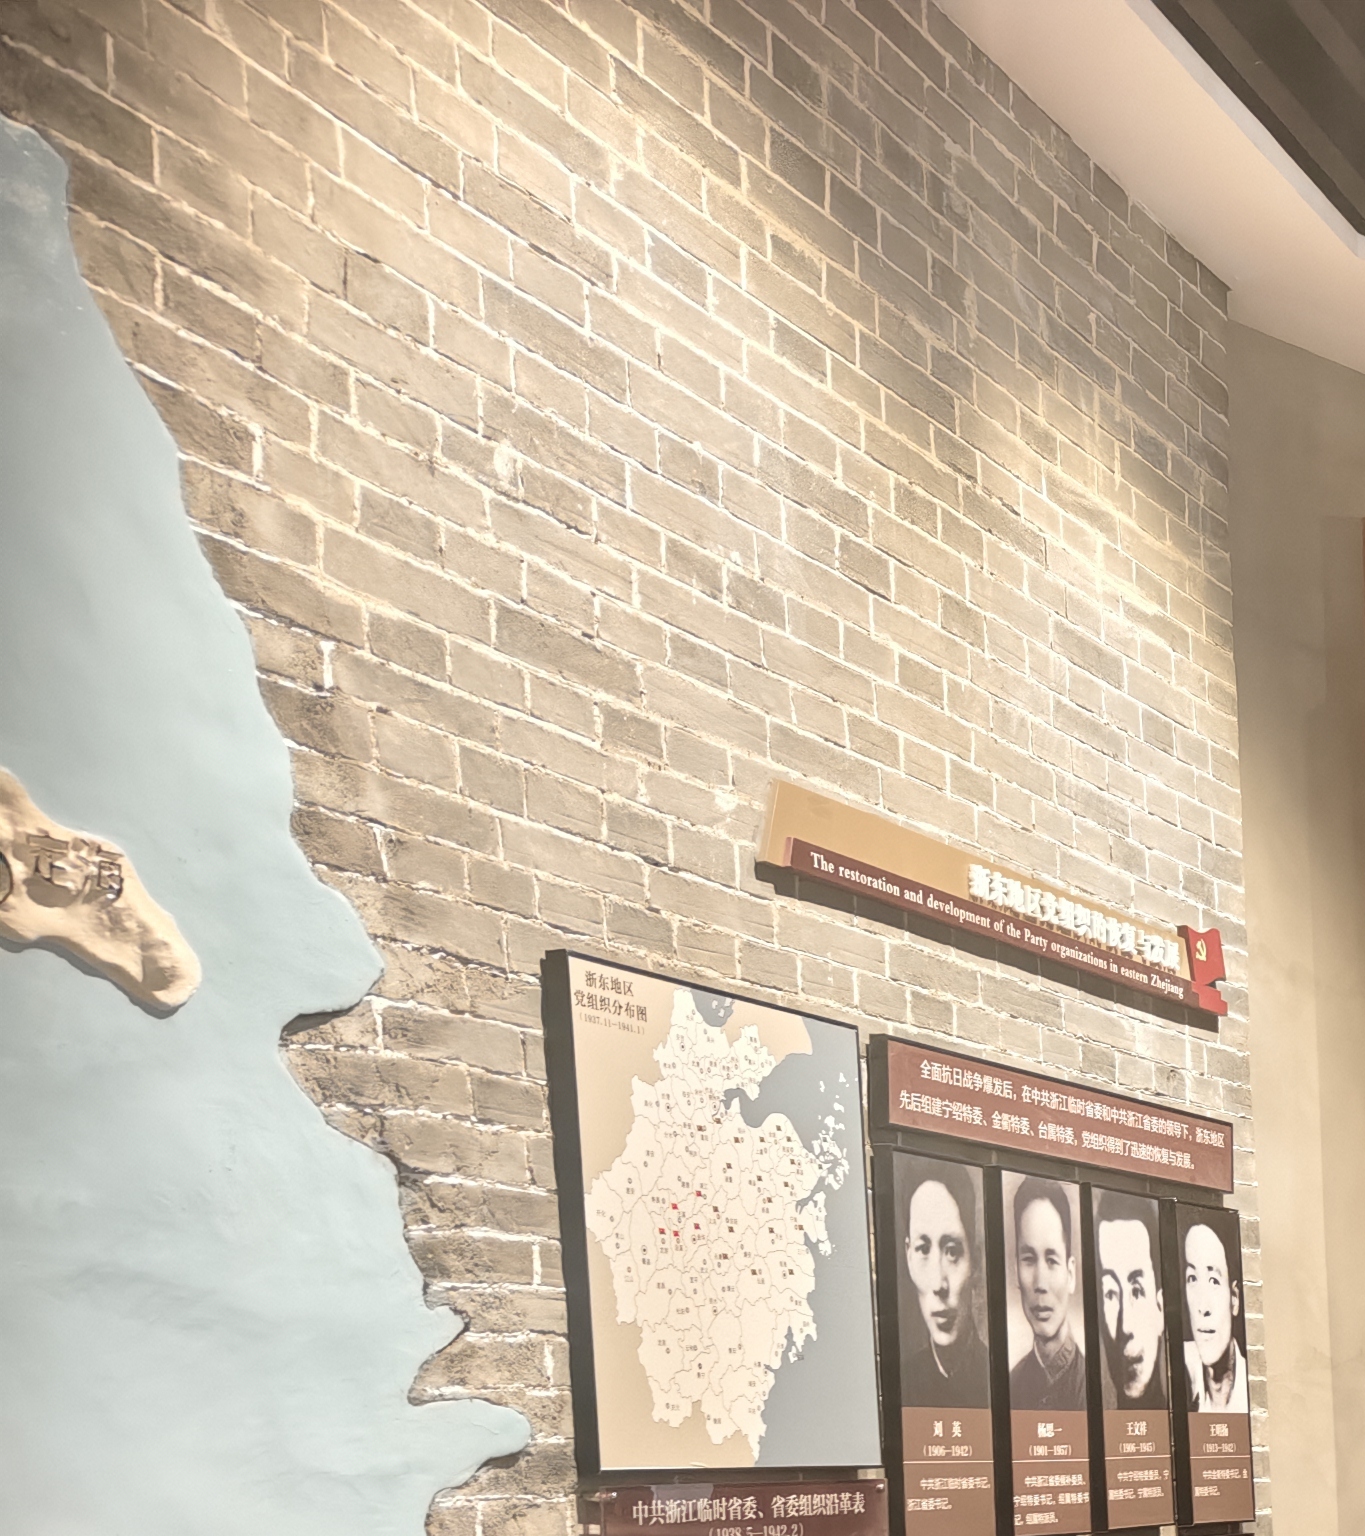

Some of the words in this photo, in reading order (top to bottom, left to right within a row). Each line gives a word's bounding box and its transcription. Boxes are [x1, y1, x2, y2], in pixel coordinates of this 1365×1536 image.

[810, 851, 835, 874] The
[838, 863, 900, 897] restoration
[904, 886, 923, 906] and
[926, 893, 991, 928] development
[994, 917, 1005, 933] of
[1007, 922, 1022, 939] the
[1024, 928, 1049, 953] Party
[1051, 941, 1108, 972] organizations
[1109, 958, 1119, 974] in
[1120, 964, 1148, 986] eastern
[1150, 974, 1184, 1000] Zhejiang
[967, 863, 1181, 972] 浙东地区党组织的恢复与发展
[585, 970, 634, 997] 浙东地区
[574, 989, 648, 1023] 党组织分布图
[632, 1492, 866, 1526] 中共浙江临时省委、省委组织沿革表
